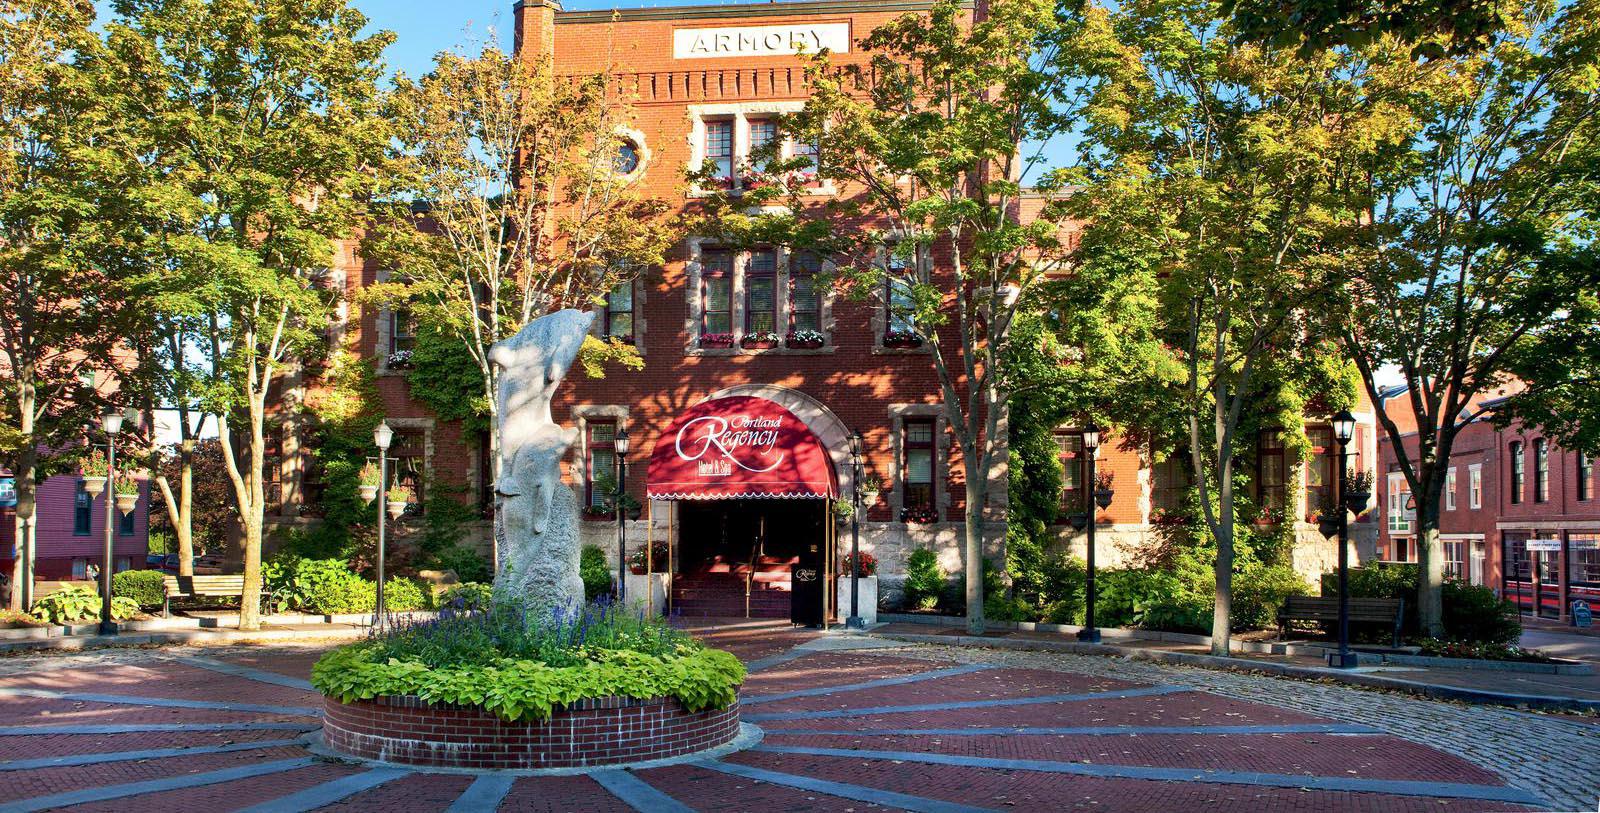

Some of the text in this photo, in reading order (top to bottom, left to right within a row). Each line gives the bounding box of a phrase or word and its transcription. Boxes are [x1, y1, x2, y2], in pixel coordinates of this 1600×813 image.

[691, 29, 825, 52] ARMORY
[731, 414, 783, 429] Portland
[676, 416, 784, 472] Regency
